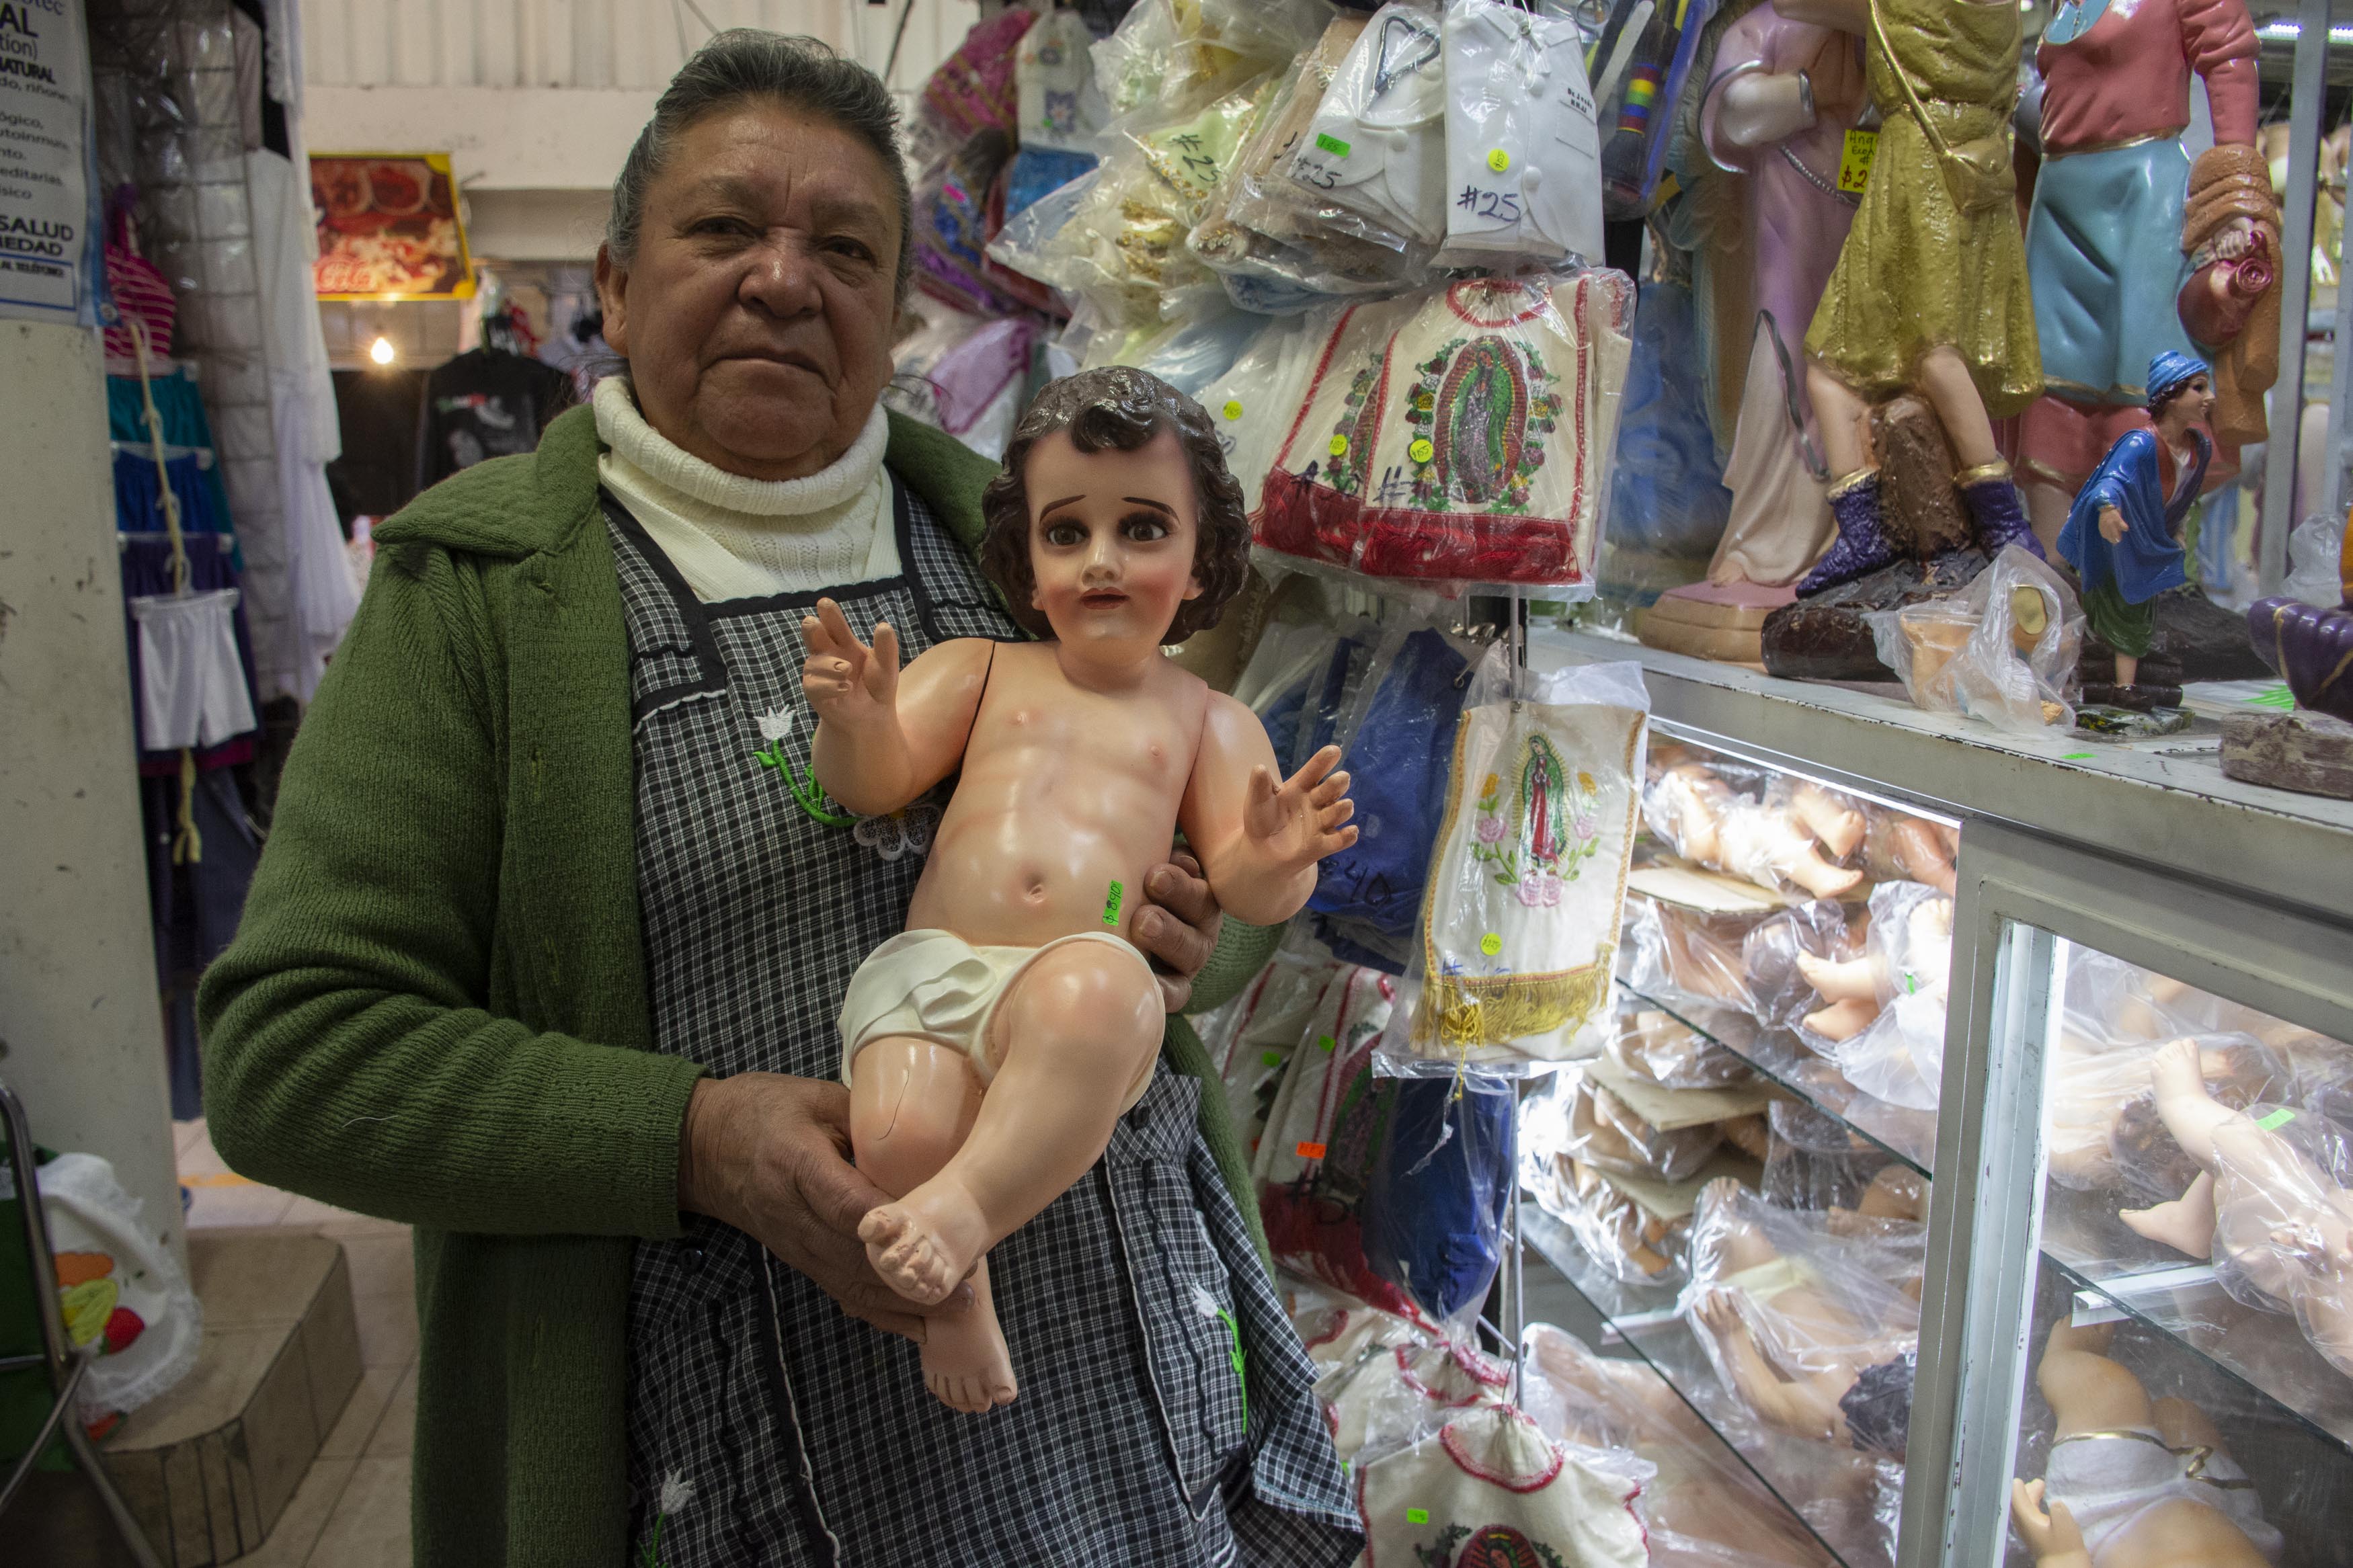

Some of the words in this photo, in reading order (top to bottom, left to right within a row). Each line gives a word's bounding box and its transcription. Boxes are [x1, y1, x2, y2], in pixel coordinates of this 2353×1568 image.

[0, 3, 40, 38] AL
[1457, 185, 1521, 222] #25
[0, 214, 74, 242] SALUD
